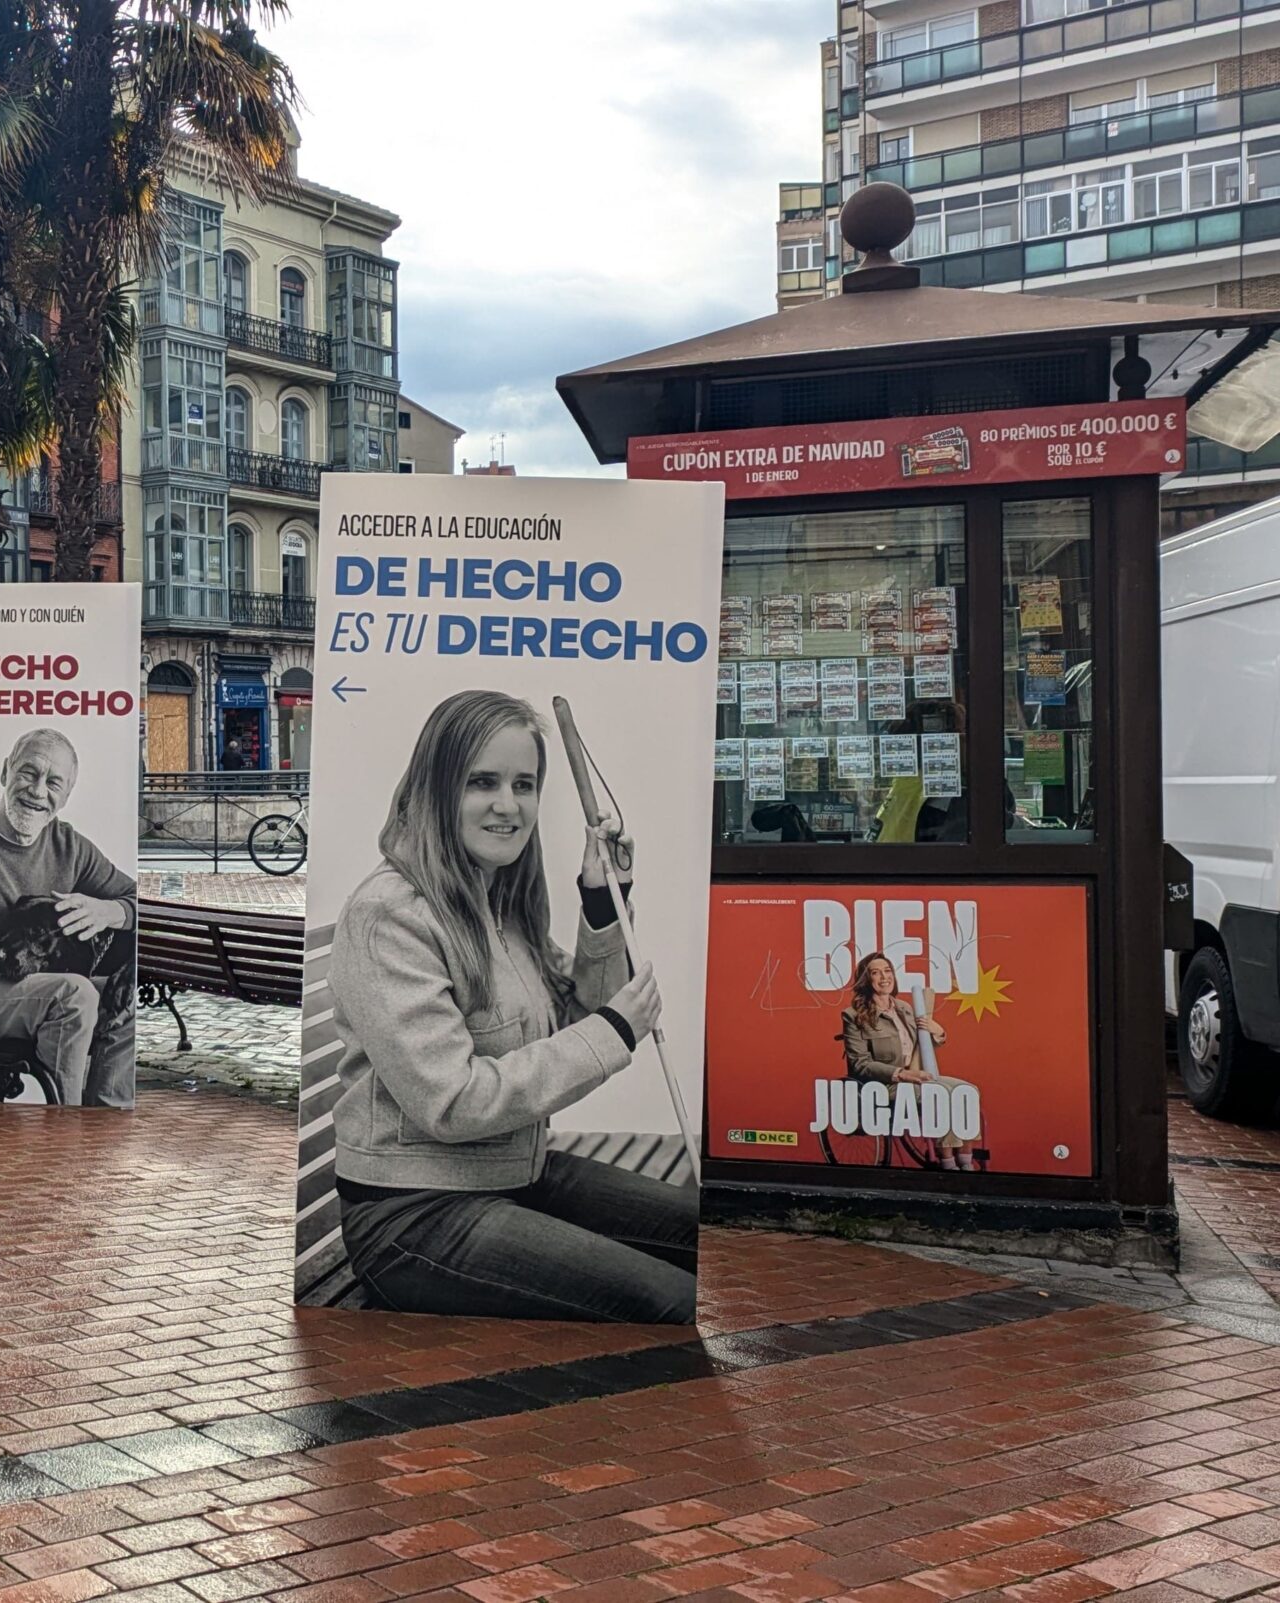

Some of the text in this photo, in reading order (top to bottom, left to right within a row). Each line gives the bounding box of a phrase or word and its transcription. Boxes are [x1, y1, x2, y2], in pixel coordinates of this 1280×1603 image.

[980, 413, 1177, 442] 80 PREMIOS DE 400.000 €
[663, 439, 885, 472] CUPÓN EXTRA DE NAVIDAD
[1048, 441, 1107, 457] POR 10 €
[1048, 454, 1072, 466] SOLO
[1084, 457, 1104, 465] CUPÓN
[745, 469, 799, 483] 1 DE ENERO
[338, 513, 562, 541] ACCEDER A LA EDUCACIÓN
[335, 555, 622, 603] DE HECHO
[20, 608, 27, 623] Y
[29, 608, 51, 623] CON
[53, 605, 85, 624] QUIÉN
[329, 611, 708, 663] ES TU DERECHO
[804, 899, 979, 995] BIEN
[810, 1079, 982, 1141] JUGADO
[759, 1133, 794, 1143] ONCE
